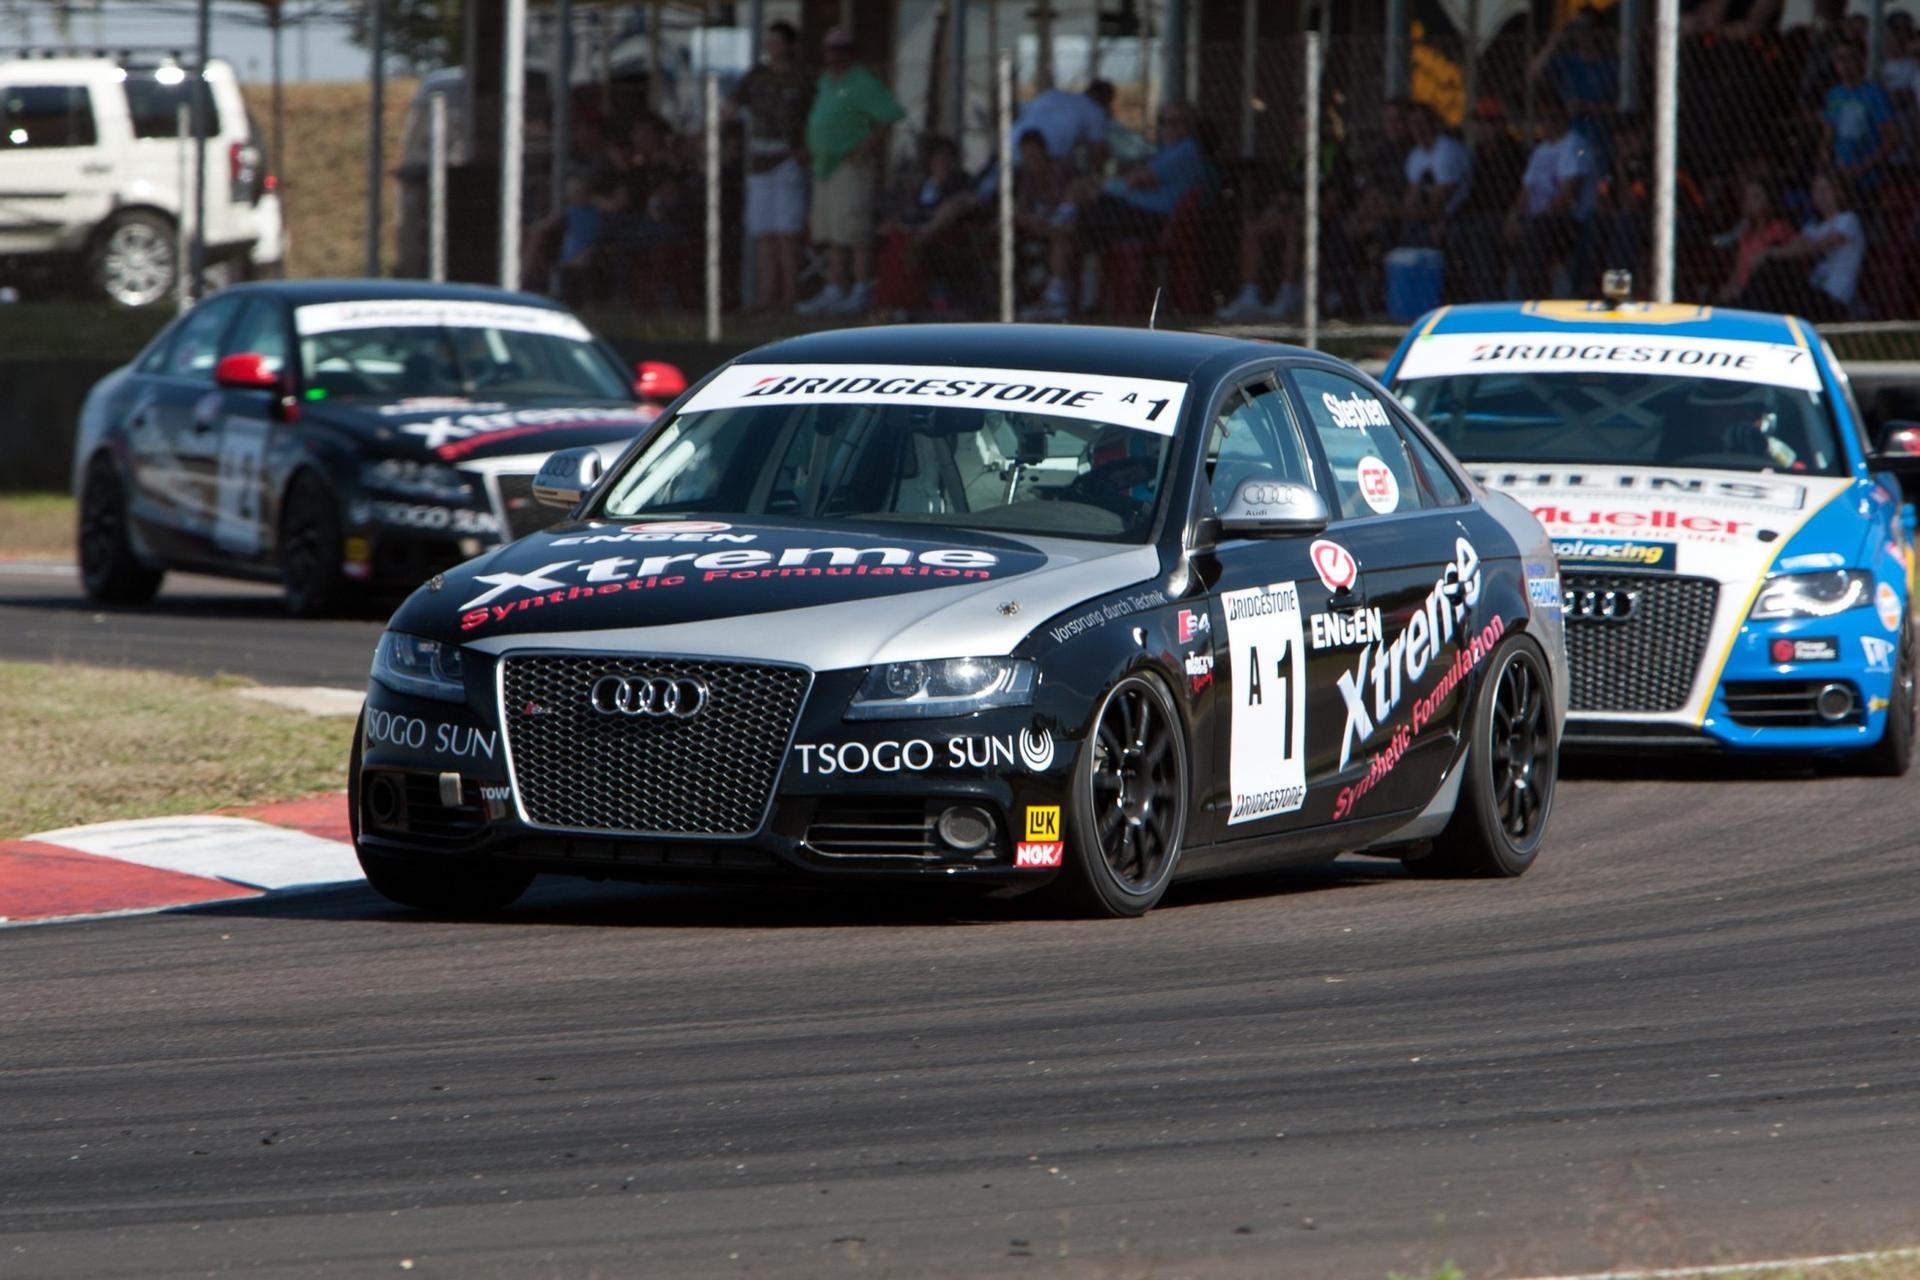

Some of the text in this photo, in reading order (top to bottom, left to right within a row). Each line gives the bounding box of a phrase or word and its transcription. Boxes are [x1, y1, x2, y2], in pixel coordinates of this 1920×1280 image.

[1471, 344, 1758, 371] BRIDGESTONE
[742, 376, 1171, 422] BRIDGESTONE A 1
[1471, 471, 1772, 500] HLINS
[1245, 509, 1268, 517] Audi
[549, 533, 758, 547] ENGEN
[459, 546, 999, 612] Xtreme
[460, 562, 991, 631] Synthetic Formulation
[1049, 589, 1169, 644] Vorsprung durch Technik
[1228, 589, 1296, 621] BRIDGESTONE
[1310, 606, 1383, 650] ENGEN
[1337, 537, 1481, 773] Xtreme
[1248, 639, 1294, 761] A 1
[1332, 613, 1505, 821] Synthetic Formulation
[435, 723, 497, 759] SUN
[794, 735, 1015, 775] TSOGO SUN
[479, 786, 510, 800] TOW
[1233, 786, 1304, 819] BRIDGESTONE
[1016, 844, 1052, 866] NGK
